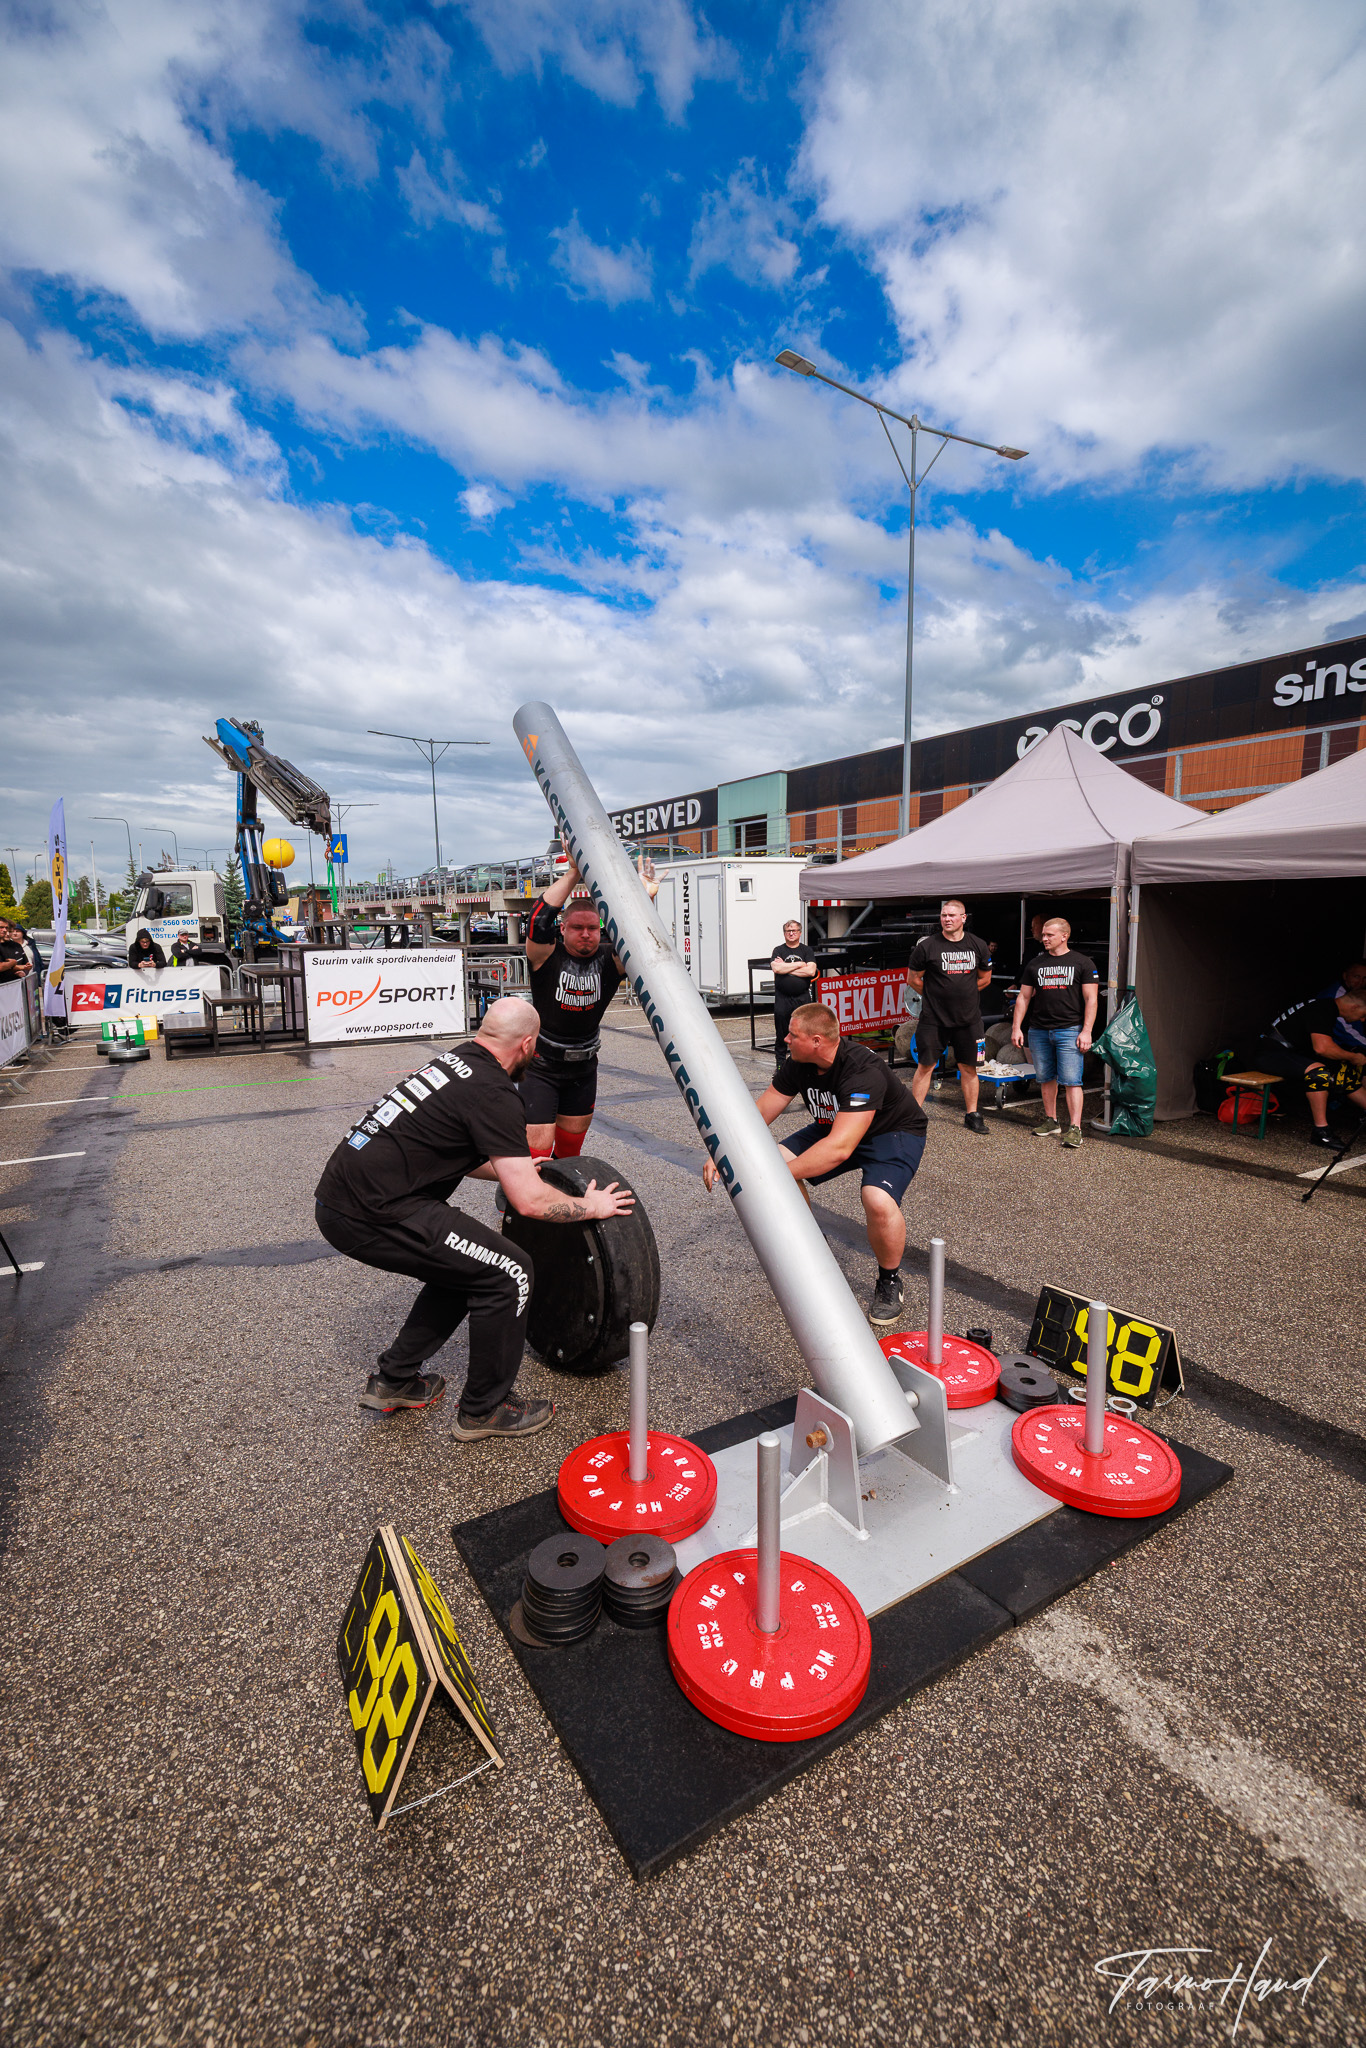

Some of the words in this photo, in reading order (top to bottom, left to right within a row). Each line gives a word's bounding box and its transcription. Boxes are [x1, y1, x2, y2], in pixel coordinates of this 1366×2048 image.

[1016, 703, 1162, 761] eco
[334, 841, 345, 855] 4
[312, 956, 348, 966] Suurim
[351, 956, 374, 965] valik
[376, 954, 456, 966] spordivahendeid!
[821, 980, 843, 991] SIIN
[846, 976, 877, 988] VÕIKS
[880, 973, 905, 984] OLLA
[75, 991, 101, 1005] 24
[125, 988, 201, 1003] fitness
[316, 990, 363, 1006] POP
[378, 984, 456, 1004] SPORT!
[345, 1021, 434, 1034] www.popsport.ee
